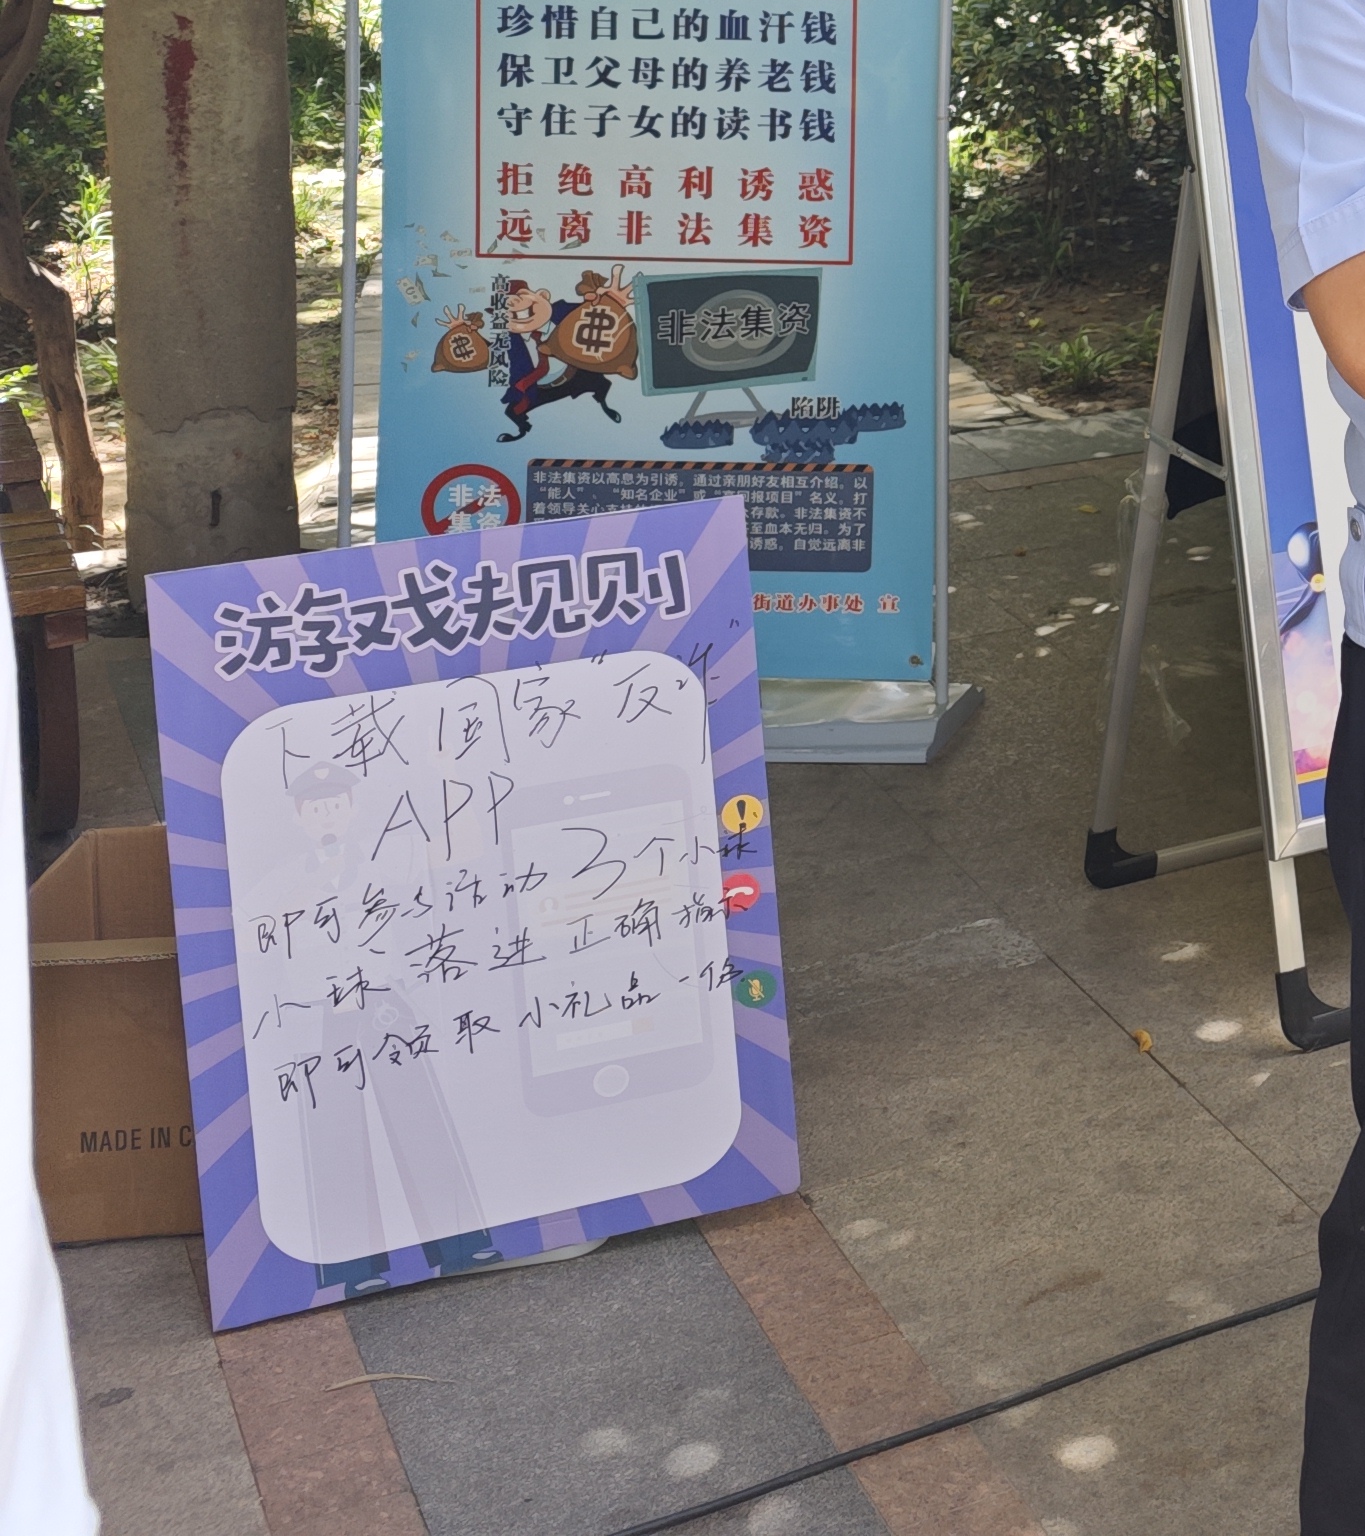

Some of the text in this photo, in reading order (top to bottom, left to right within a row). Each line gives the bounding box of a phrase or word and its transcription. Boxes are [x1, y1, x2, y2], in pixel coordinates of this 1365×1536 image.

[497, 4, 837, 45] 珍惜自己的血汗钱
[497, 53, 836, 94] 保卫父母的养老钱
[497, 102, 836, 143] 守住子女的读书钱
[496, 161, 834, 202] 拒绝高利诱惑
[496, 208, 832, 249] 远离非法集资
[488, 273, 510, 388] 高收益无风险
[657, 302, 811, 346] 非法集资
[790, 395, 841, 420] 陷阱
[448, 483, 502, 507] 非法
[217, 549, 690, 677] 游戏规则
[753, 592, 864, 614] 街道办事处
[372, 772, 514, 860] APP
[80, 1128, 142, 1154] MADE
[150, 1126, 171, 1148] IN
